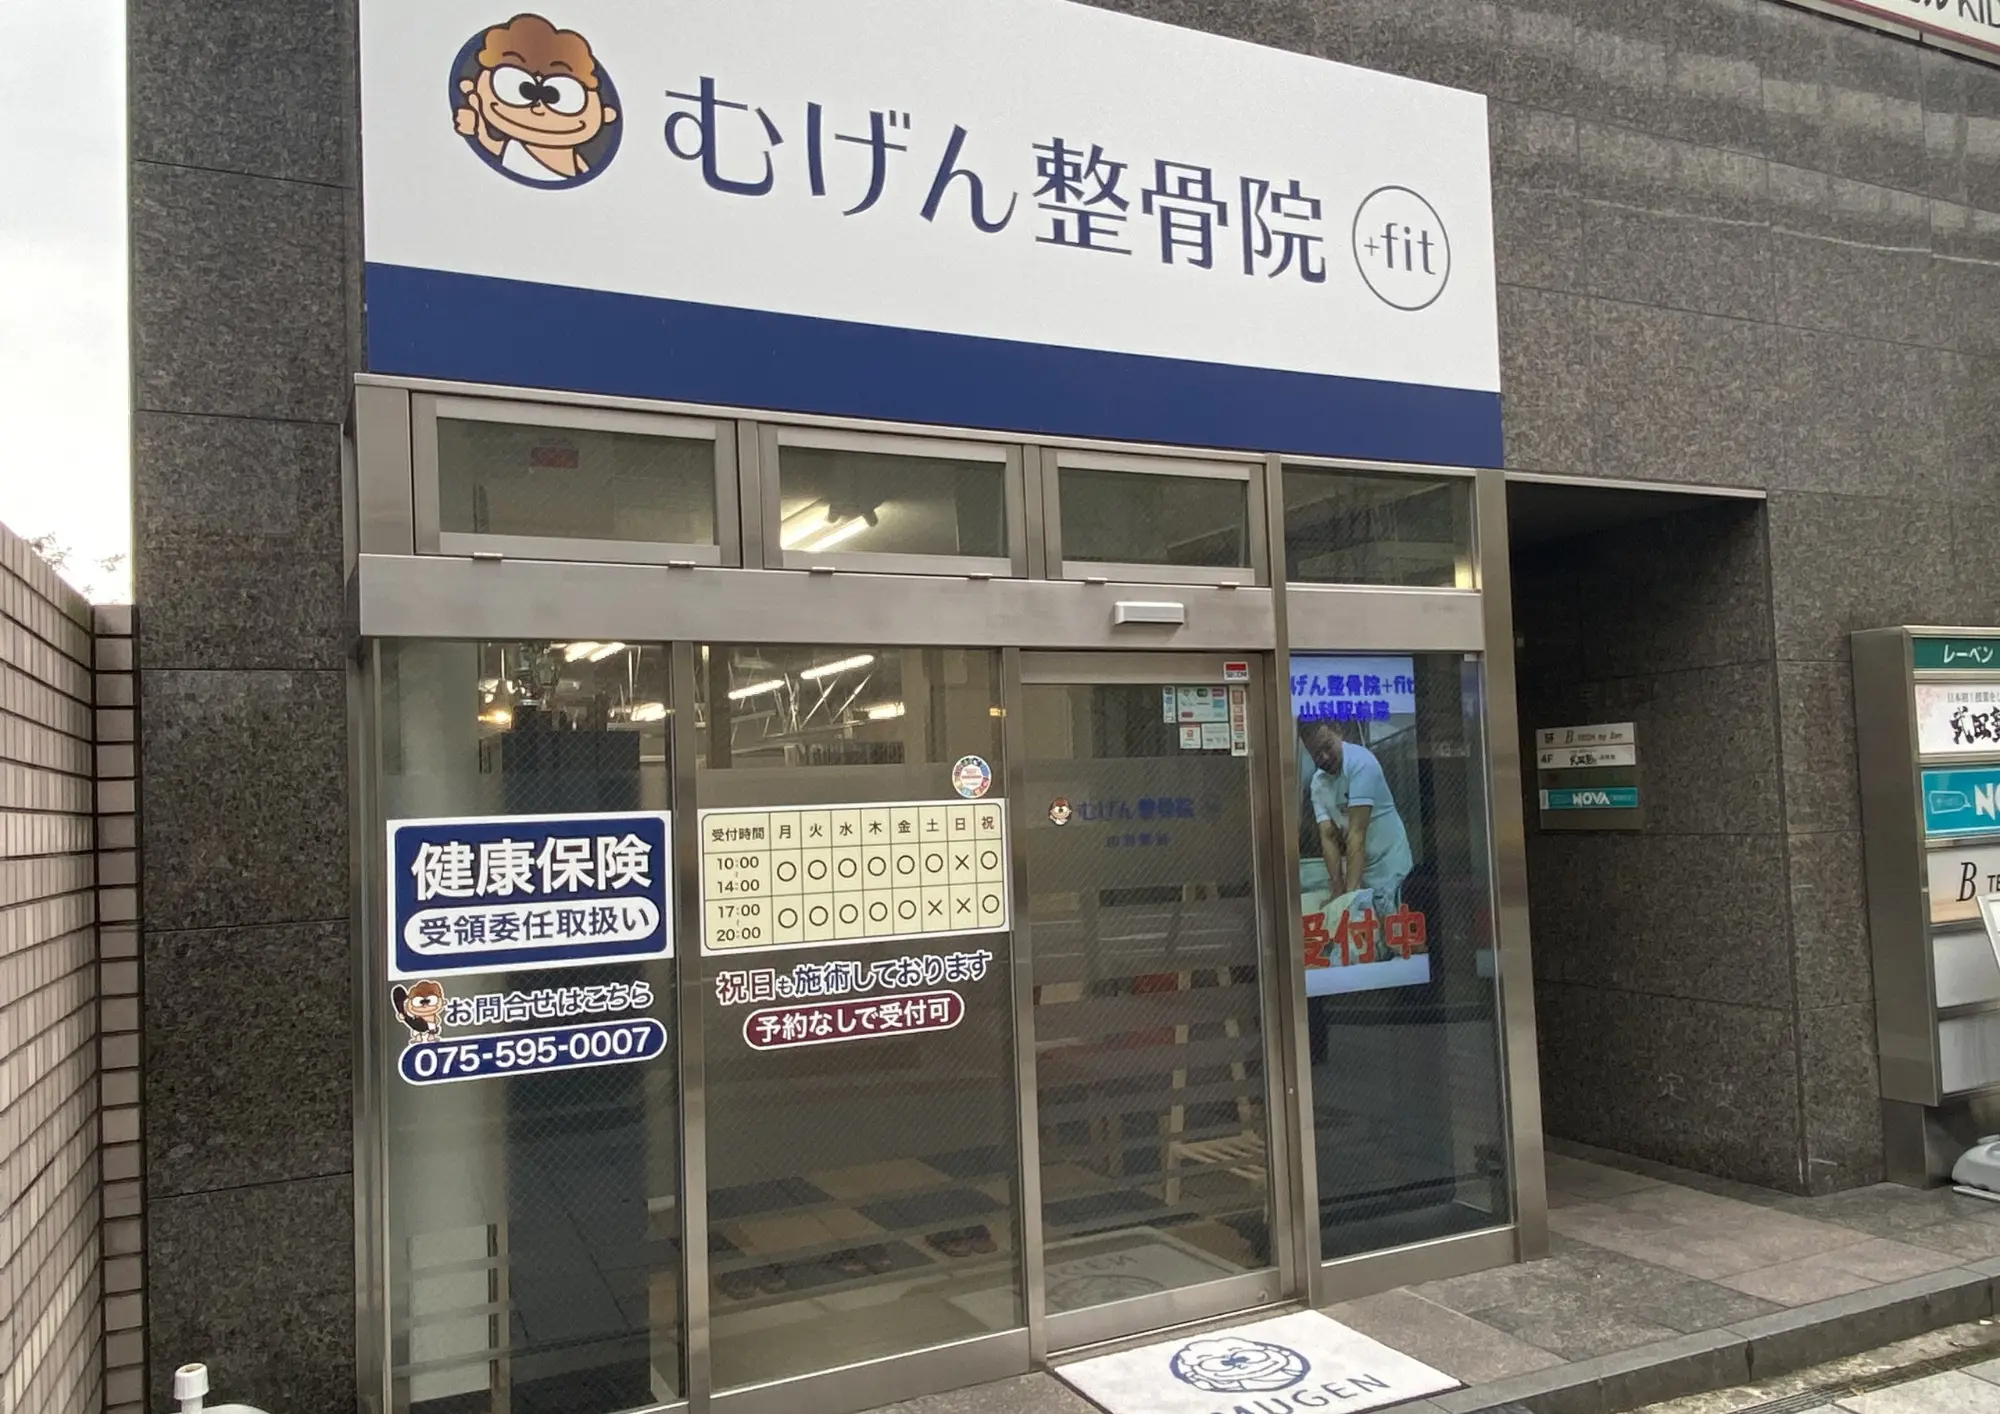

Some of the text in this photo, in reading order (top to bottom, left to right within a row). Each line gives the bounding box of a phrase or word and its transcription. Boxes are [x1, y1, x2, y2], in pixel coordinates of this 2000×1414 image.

[664, 76, 1327, 284] むげん整骨院
[1363, 222, 1436, 276] +fit
[1943, 645, 1994, 663] レーベン
[1572, 792, 1610, 806] NOVA
[711, 816, 996, 842] 受付時間 月 火 水 木 金 土 日 祝
[411, 834, 652, 901] 健康保険
[717, 856, 759, 870] 10:00
[1956, 862, 1977, 901] B
[717, 879, 760, 893] 14:00
[419, 906, 650, 949] 受領委任取扱い
[718, 904, 760, 918] 17:00
[716, 927, 761, 941] 20:00
[1301, 904, 1427, 968] 受付中
[716, 952, 992, 1005] 祝日も施術しております
[445, 981, 654, 1026] お問合せはこちら
[755, 998, 951, 1043] 予約なしで受付可
[414, 1027, 652, 1077] 075-595-0007
